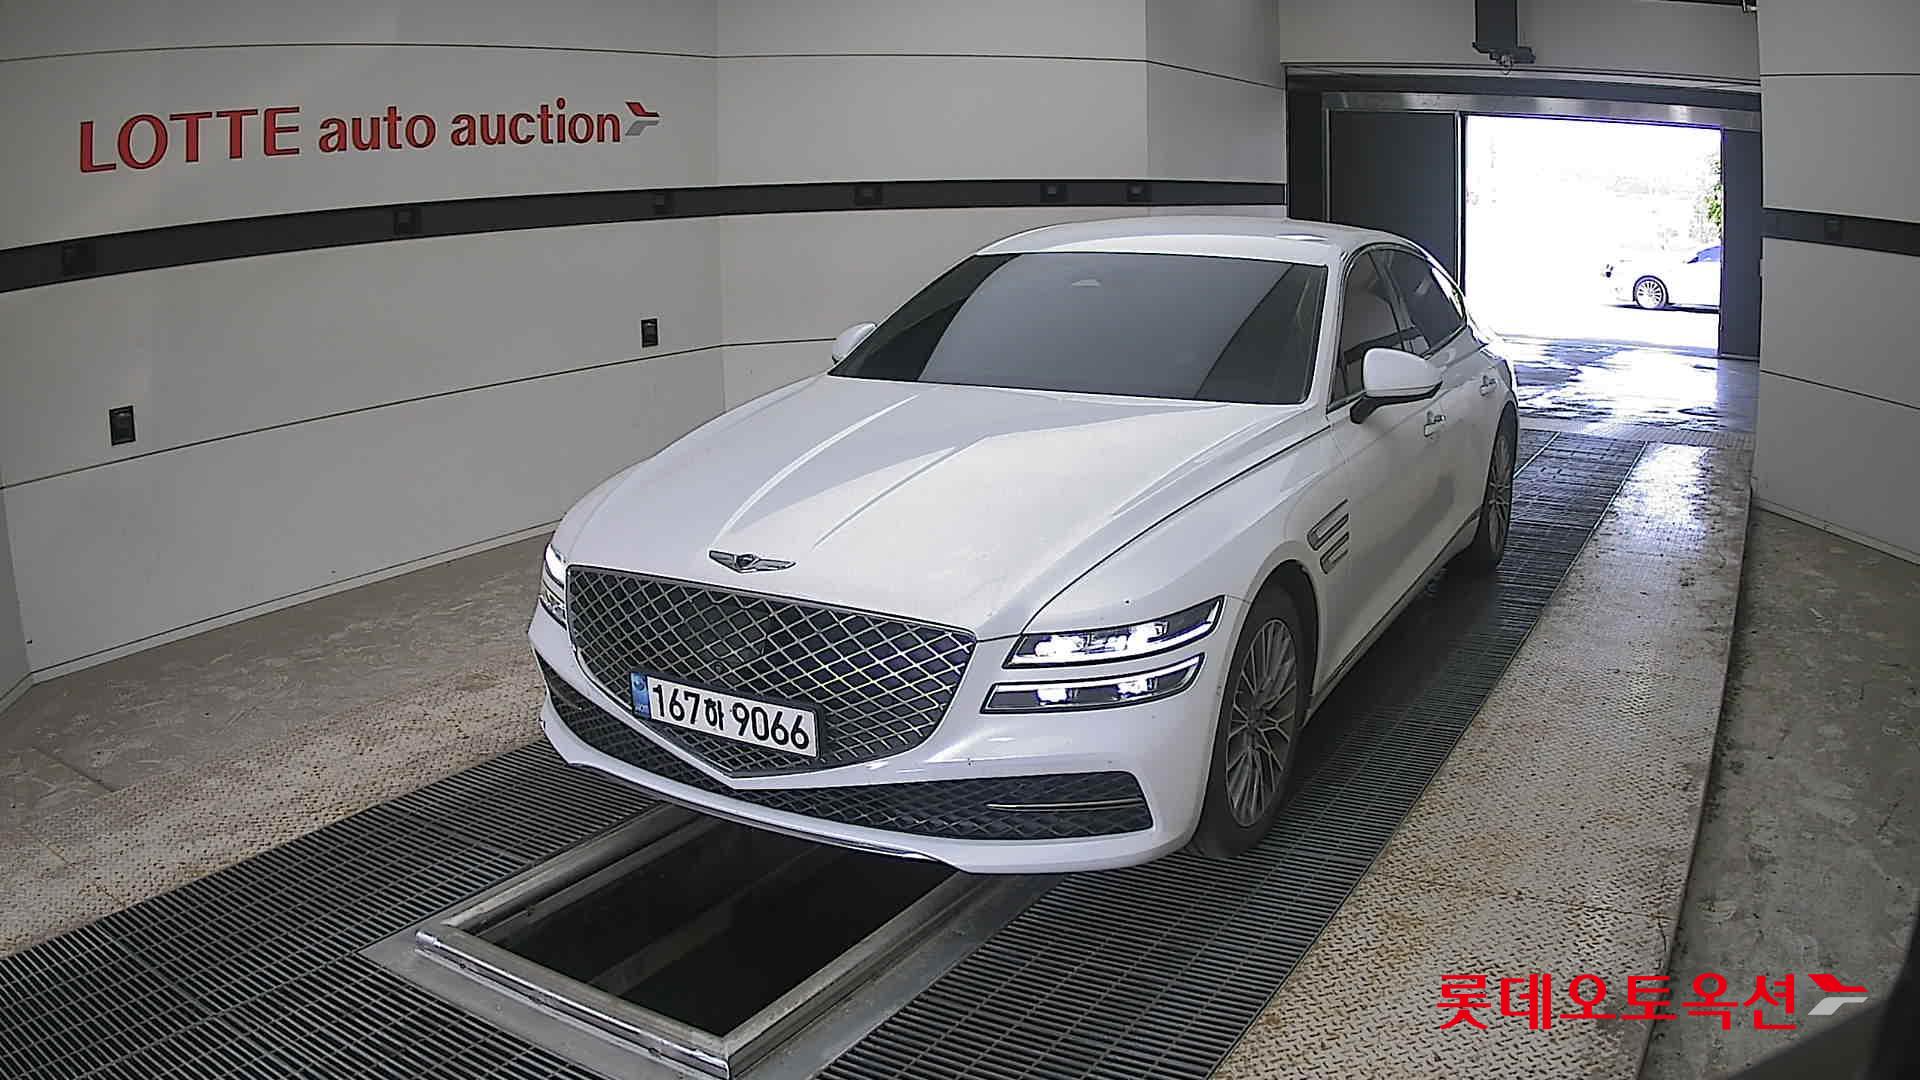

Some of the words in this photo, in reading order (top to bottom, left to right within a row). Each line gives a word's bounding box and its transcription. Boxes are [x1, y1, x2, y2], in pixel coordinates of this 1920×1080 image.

[79, 106, 300, 173] LOTTE
[318, 106, 437, 153] auto
[450, 98, 622, 146] auction
[652, 684, 724, 731] 167하
[732, 702, 810, 750] 9066
